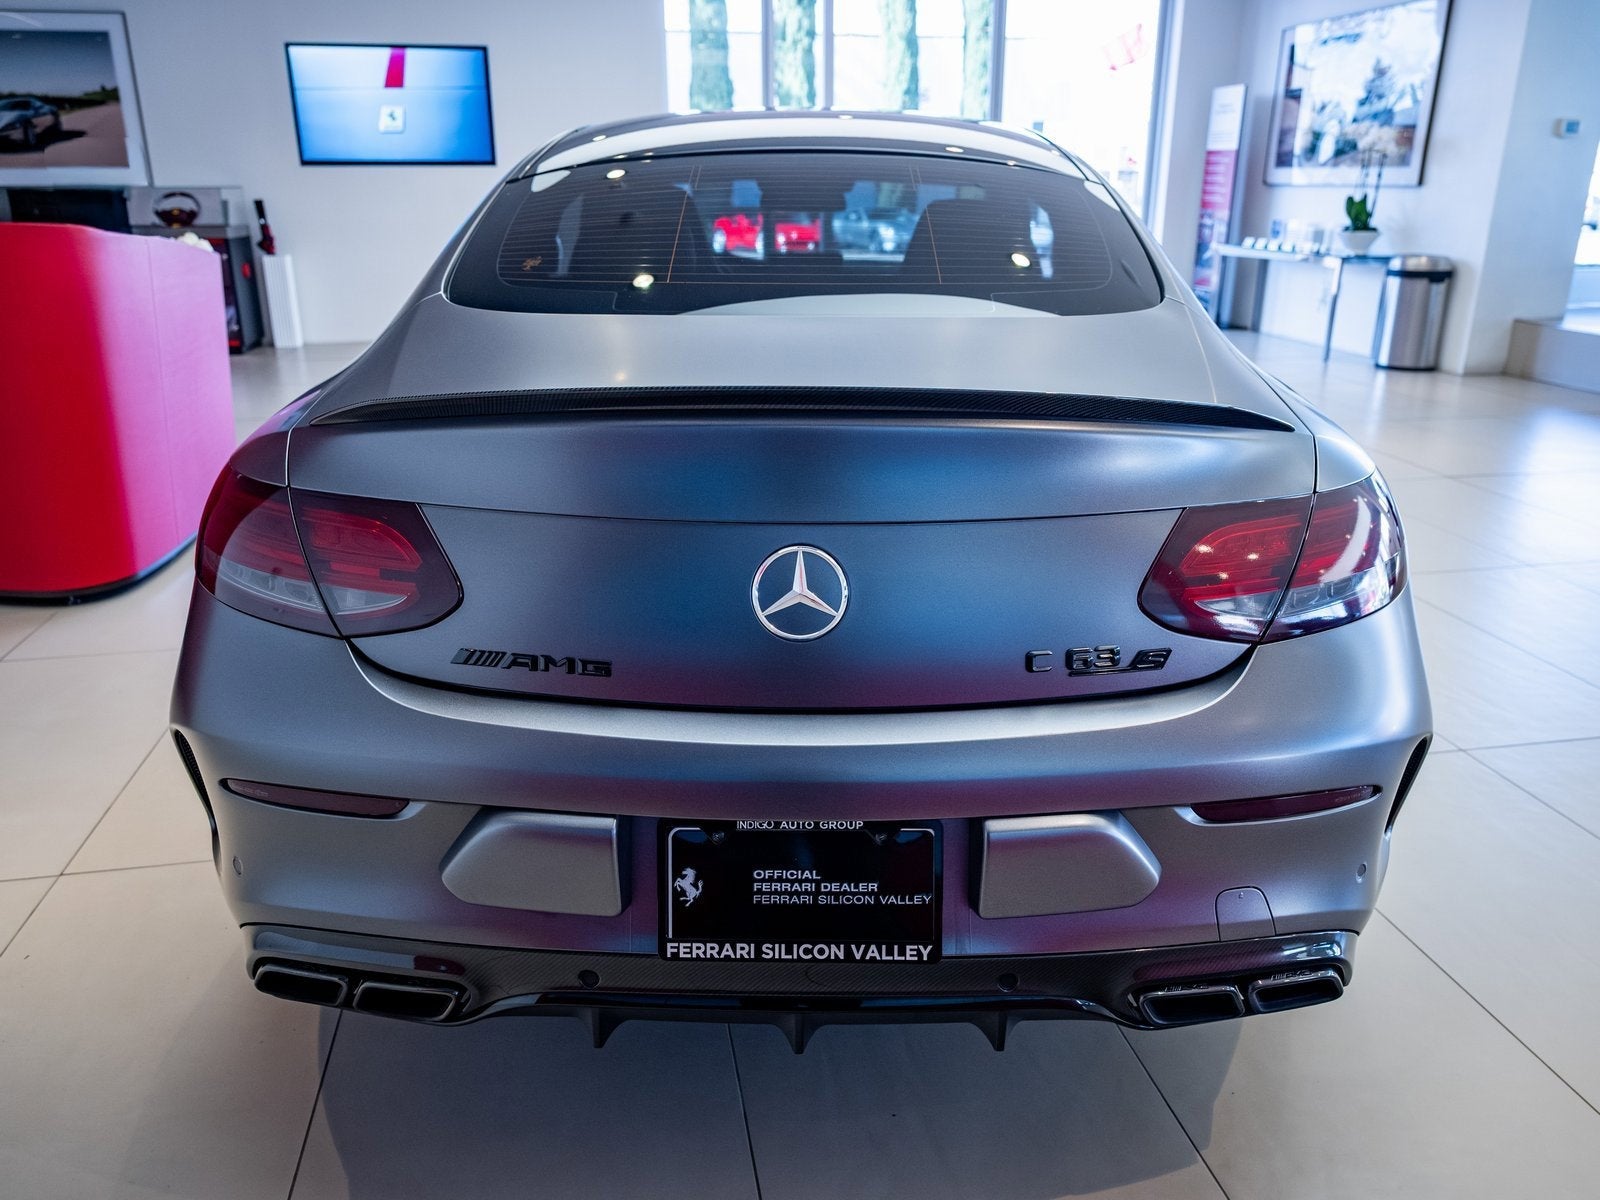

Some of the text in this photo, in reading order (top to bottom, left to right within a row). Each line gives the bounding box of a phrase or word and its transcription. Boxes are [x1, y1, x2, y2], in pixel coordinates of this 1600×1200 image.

[501, 652, 612, 677] AMG
[1025, 645, 1173, 673] C 63 S
[736, 820, 864, 830] INDIGO AUTO GROUP
[753, 869, 821, 880] OFFICIAL
[753, 882, 878, 893] FERRARI DEALER
[753, 895, 932, 905] FERRARI SILICON VALLEY
[666, 942, 933, 961] FERRARI SILICON VALLEY
